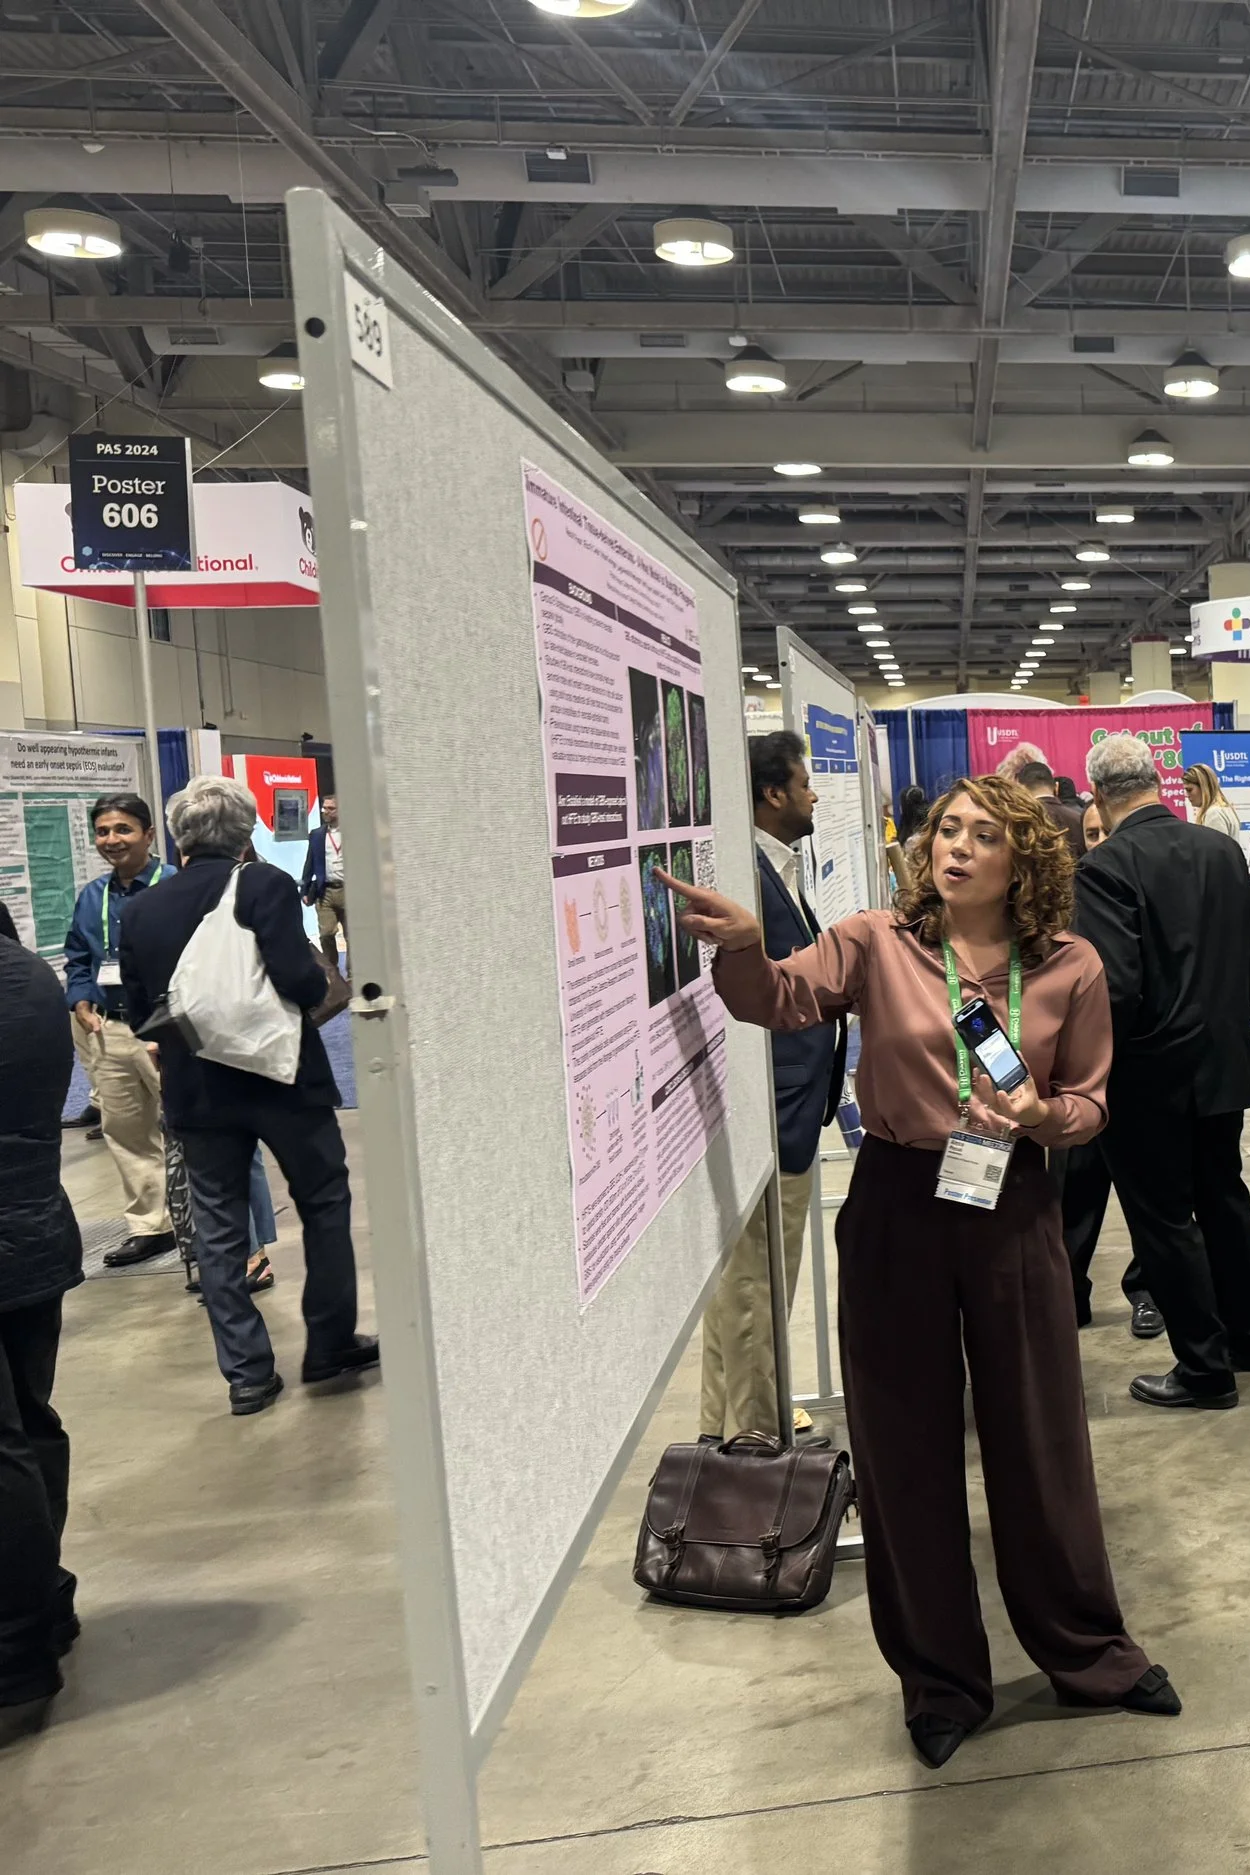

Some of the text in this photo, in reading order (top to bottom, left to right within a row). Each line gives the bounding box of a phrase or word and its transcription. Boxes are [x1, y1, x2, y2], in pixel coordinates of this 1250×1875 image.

[96, 443, 158, 456] PAS 2024
[92, 475, 166, 495] Poster
[102, 502, 159, 529] 606
[197, 553, 254, 571] tional
[1136, 727, 1174, 745] out
[17, 743, 118, 757] Do well appearing hypothermic infants
[1225, 752, 1248, 760] USDTL
[10, 760, 25, 769] need
[27, 761, 34, 769] an
[35, 760, 48, 771] early
[66, 762, 82, 772] sepsis
[1154, 750, 1183, 769] '8
[1161, 776, 1184, 785] Adva
[1234, 775, 1250, 783] Right
